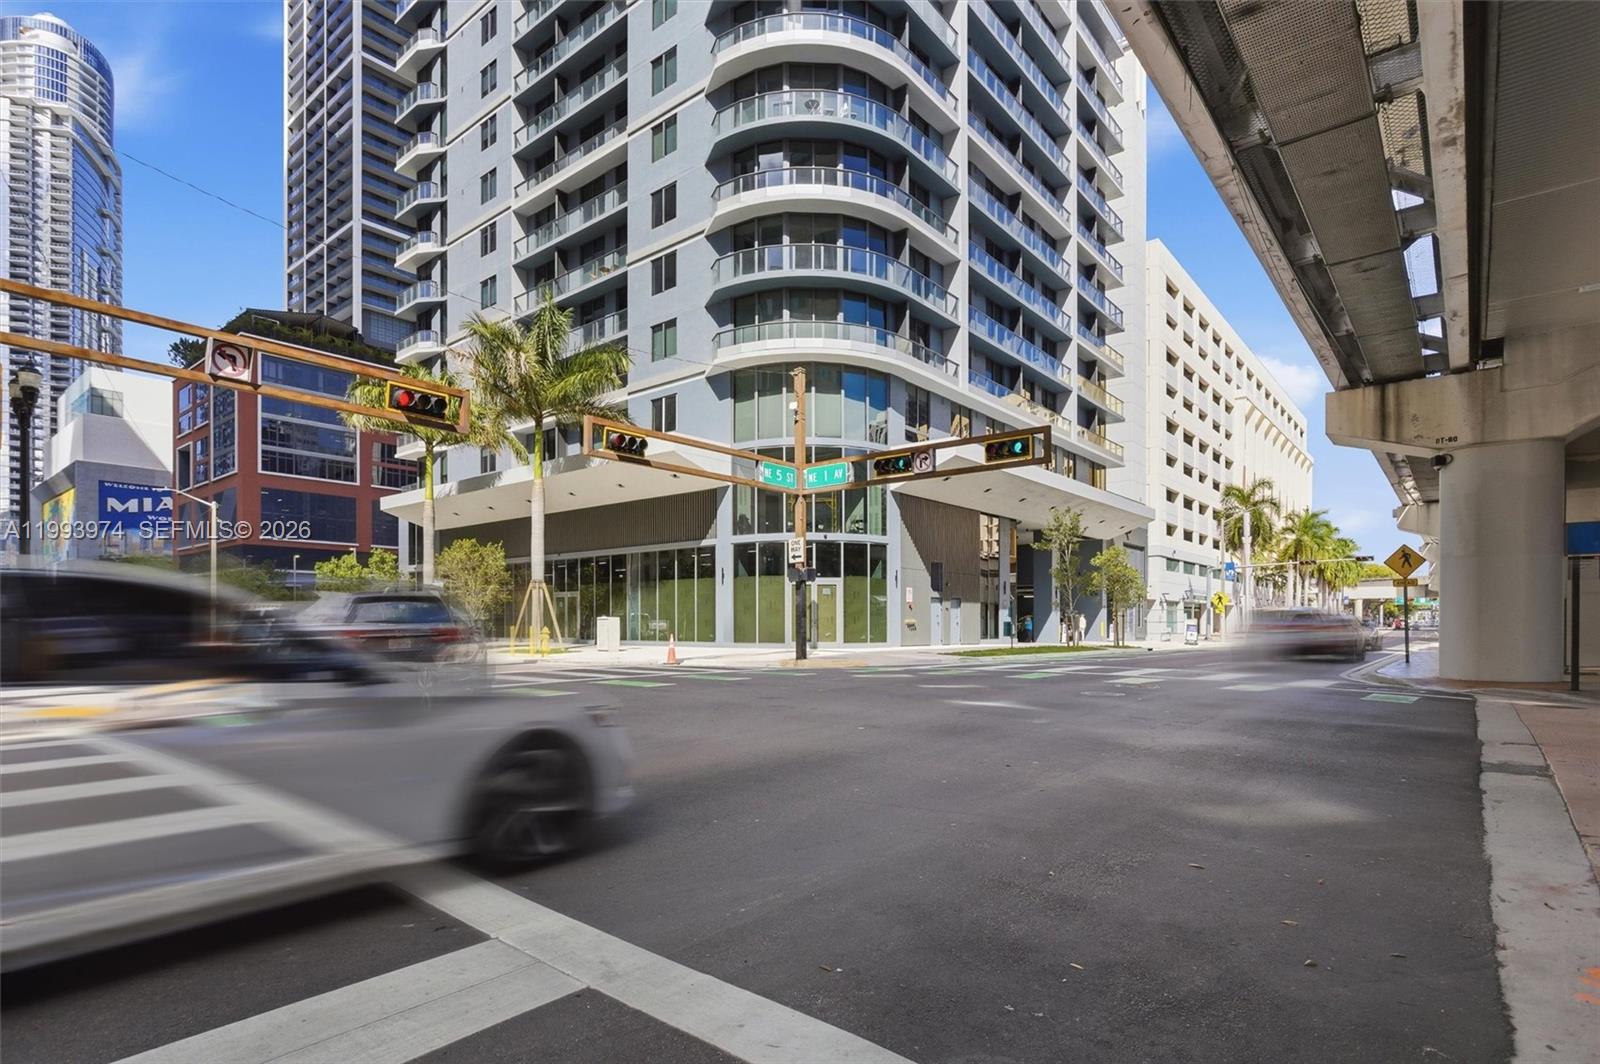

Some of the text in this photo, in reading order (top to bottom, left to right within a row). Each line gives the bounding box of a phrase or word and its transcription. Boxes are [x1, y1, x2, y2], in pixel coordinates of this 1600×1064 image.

[764, 467, 794, 483] NE 5 ST
[808, 468, 843, 483] NE 1 AV
